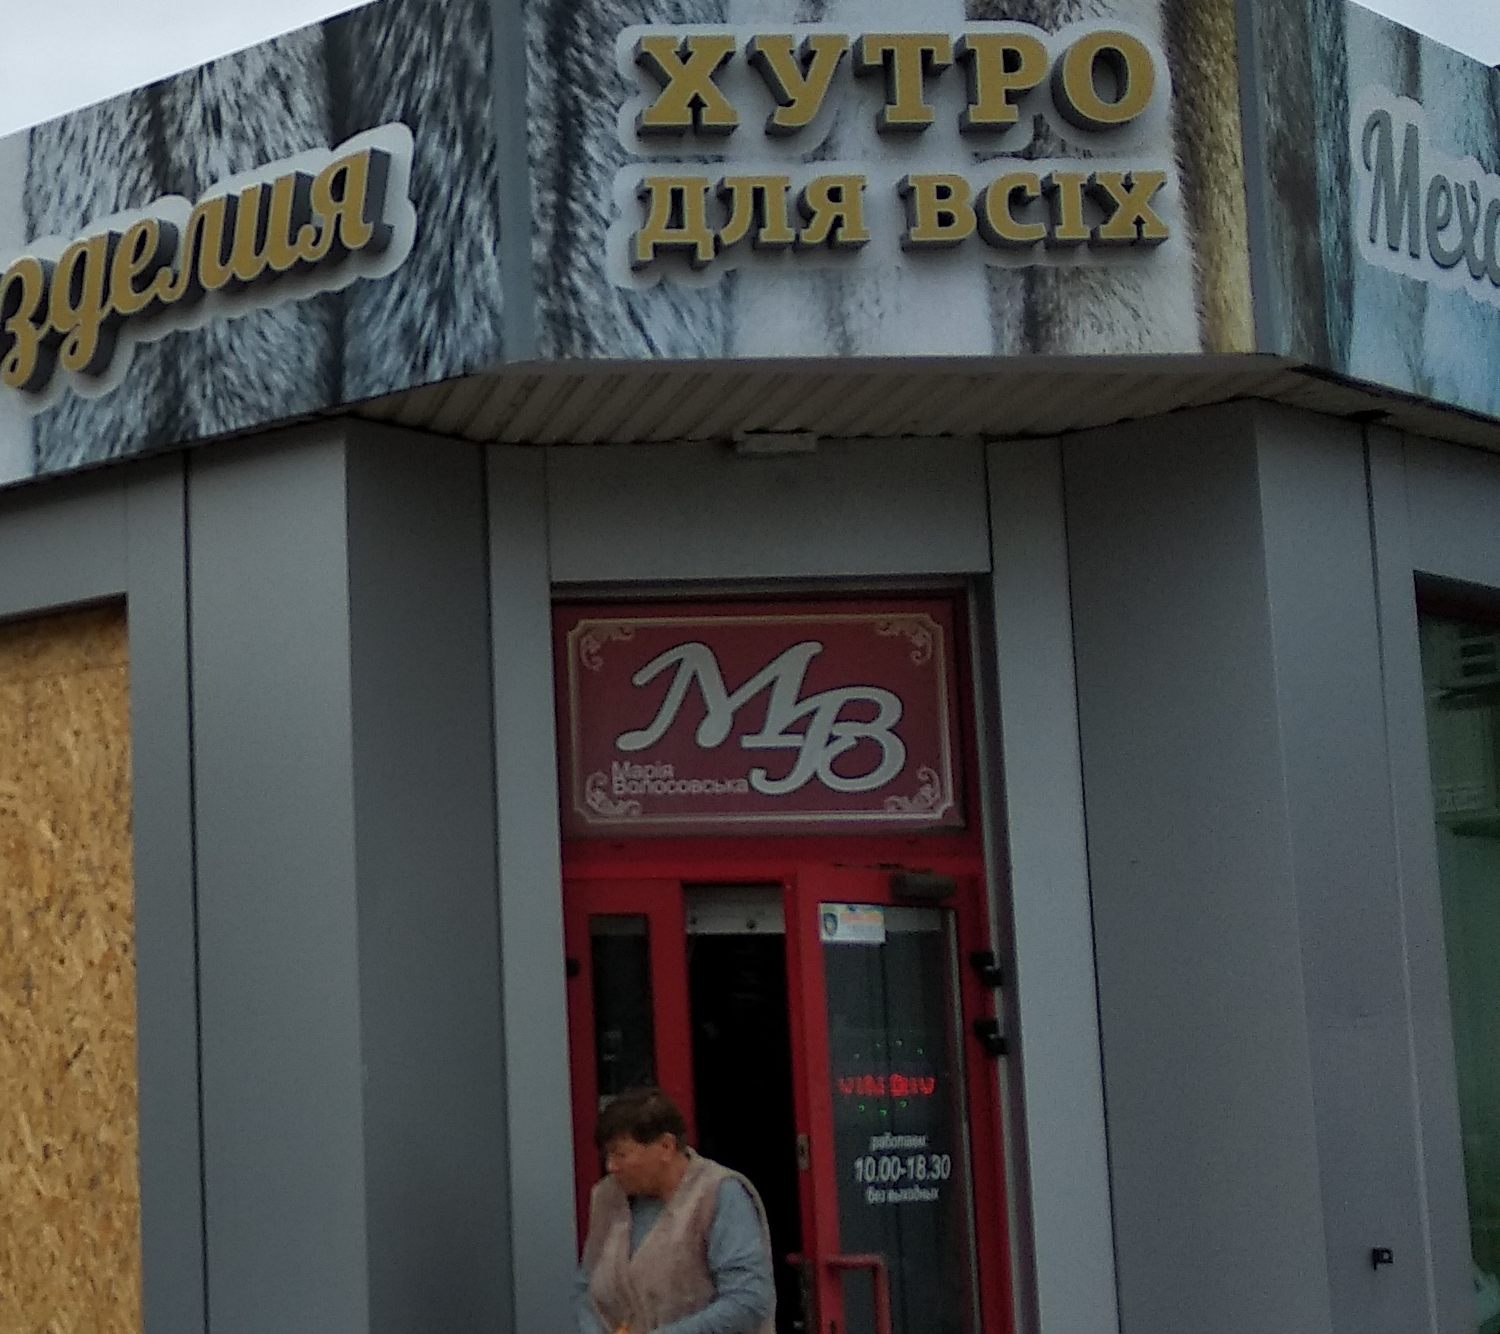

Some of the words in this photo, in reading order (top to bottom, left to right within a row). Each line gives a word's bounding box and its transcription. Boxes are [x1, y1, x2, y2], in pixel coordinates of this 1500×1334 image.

[634, 28, 1157, 136] ХУТРО
[631, 172, 870, 269] ДЛЯ
[897, 169, 1171, 250] ВСІХ
[854, 1153, 952, 1183] 10.00-18.30
